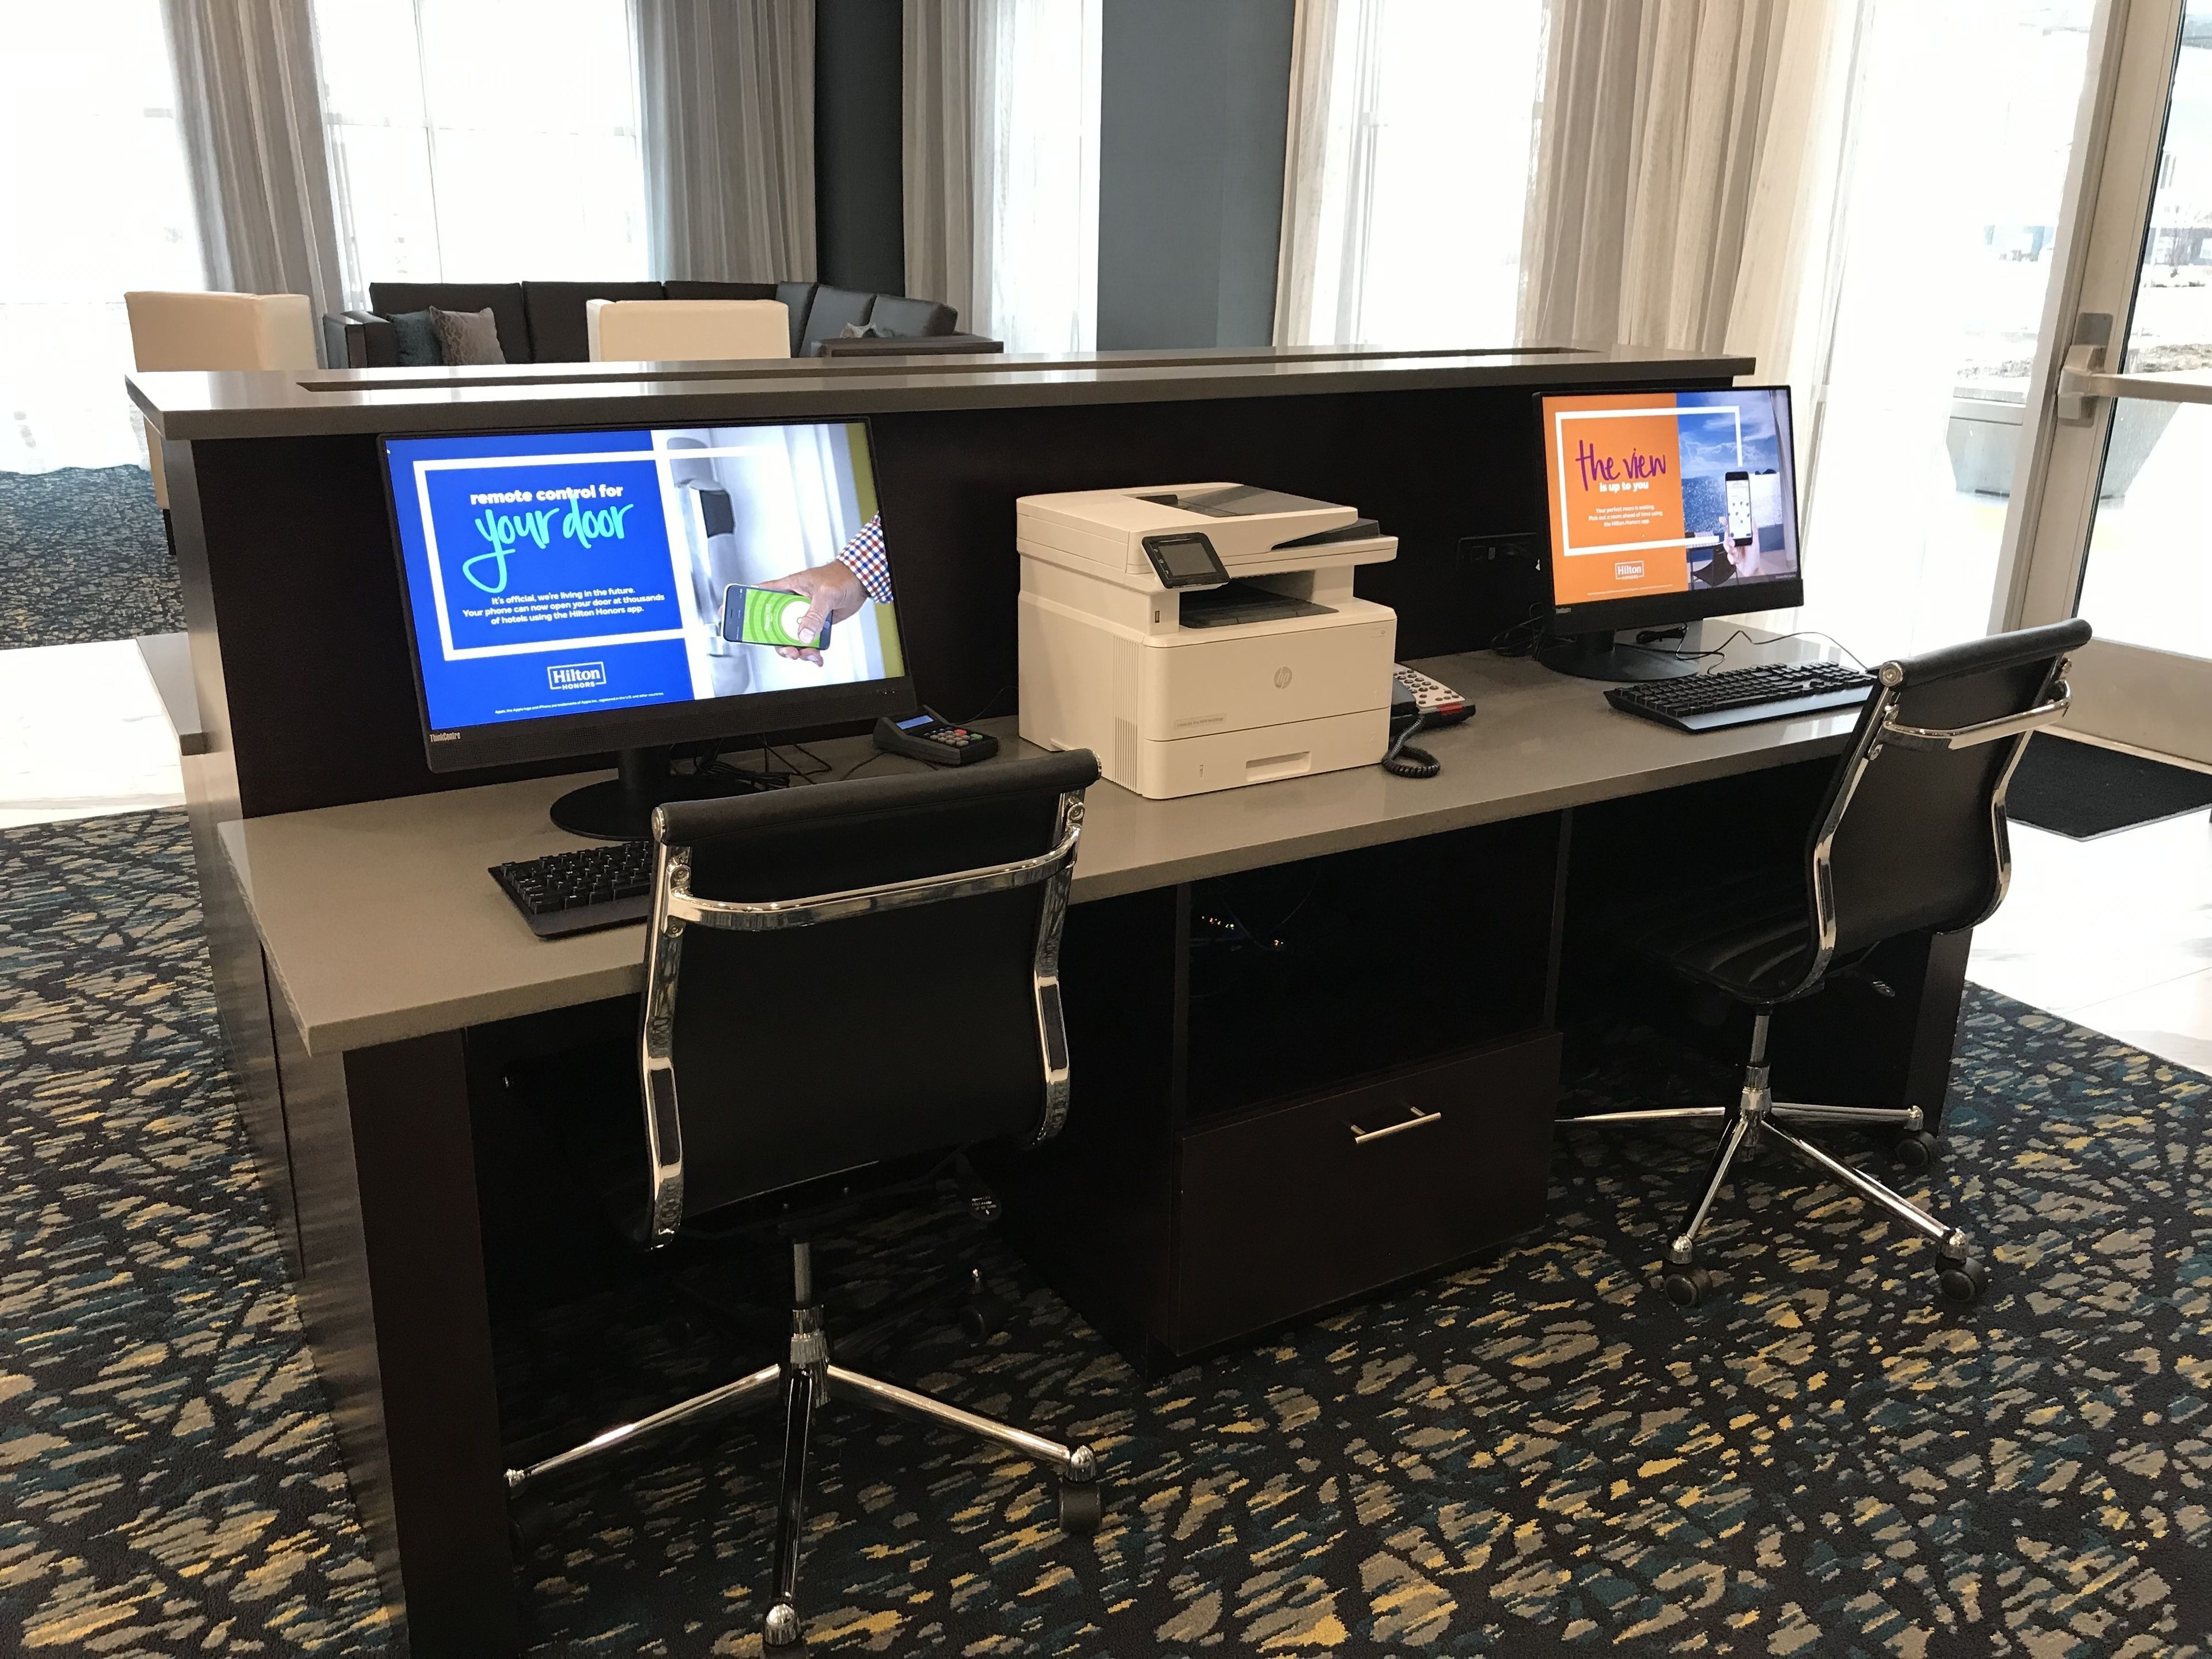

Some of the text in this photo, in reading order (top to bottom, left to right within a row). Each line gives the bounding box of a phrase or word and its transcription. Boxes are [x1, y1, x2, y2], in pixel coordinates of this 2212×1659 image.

[1575, 440, 1666, 491] the view
[470, 484, 623, 505] remote control for
[1600, 482, 1649, 493] is up to you
[463, 494, 634, 593] your door
[1618, 565, 1641, 575] Hilton
[485, 607, 512, 616] phone
[550, 603, 571, 611] open
[573, 600, 591, 609] your
[592, 599, 611, 607] door
[623, 594, 665, 604] thousands
[491, 596, 505, 605] It's
[506, 594, 537, 604] official,
[537, 592, 559, 601] we're
[491, 617, 500, 625] of
[502, 615, 528, 624] hotels
[569, 609, 594, 618] Hilton
[596, 607, 626, 615] Honors
[553, 669, 601, 683] Hilton
[1275, 666, 1291, 690] hp
[562, 681, 595, 690] HONORS
[429, 732, 461, 743] ThinkCentre
